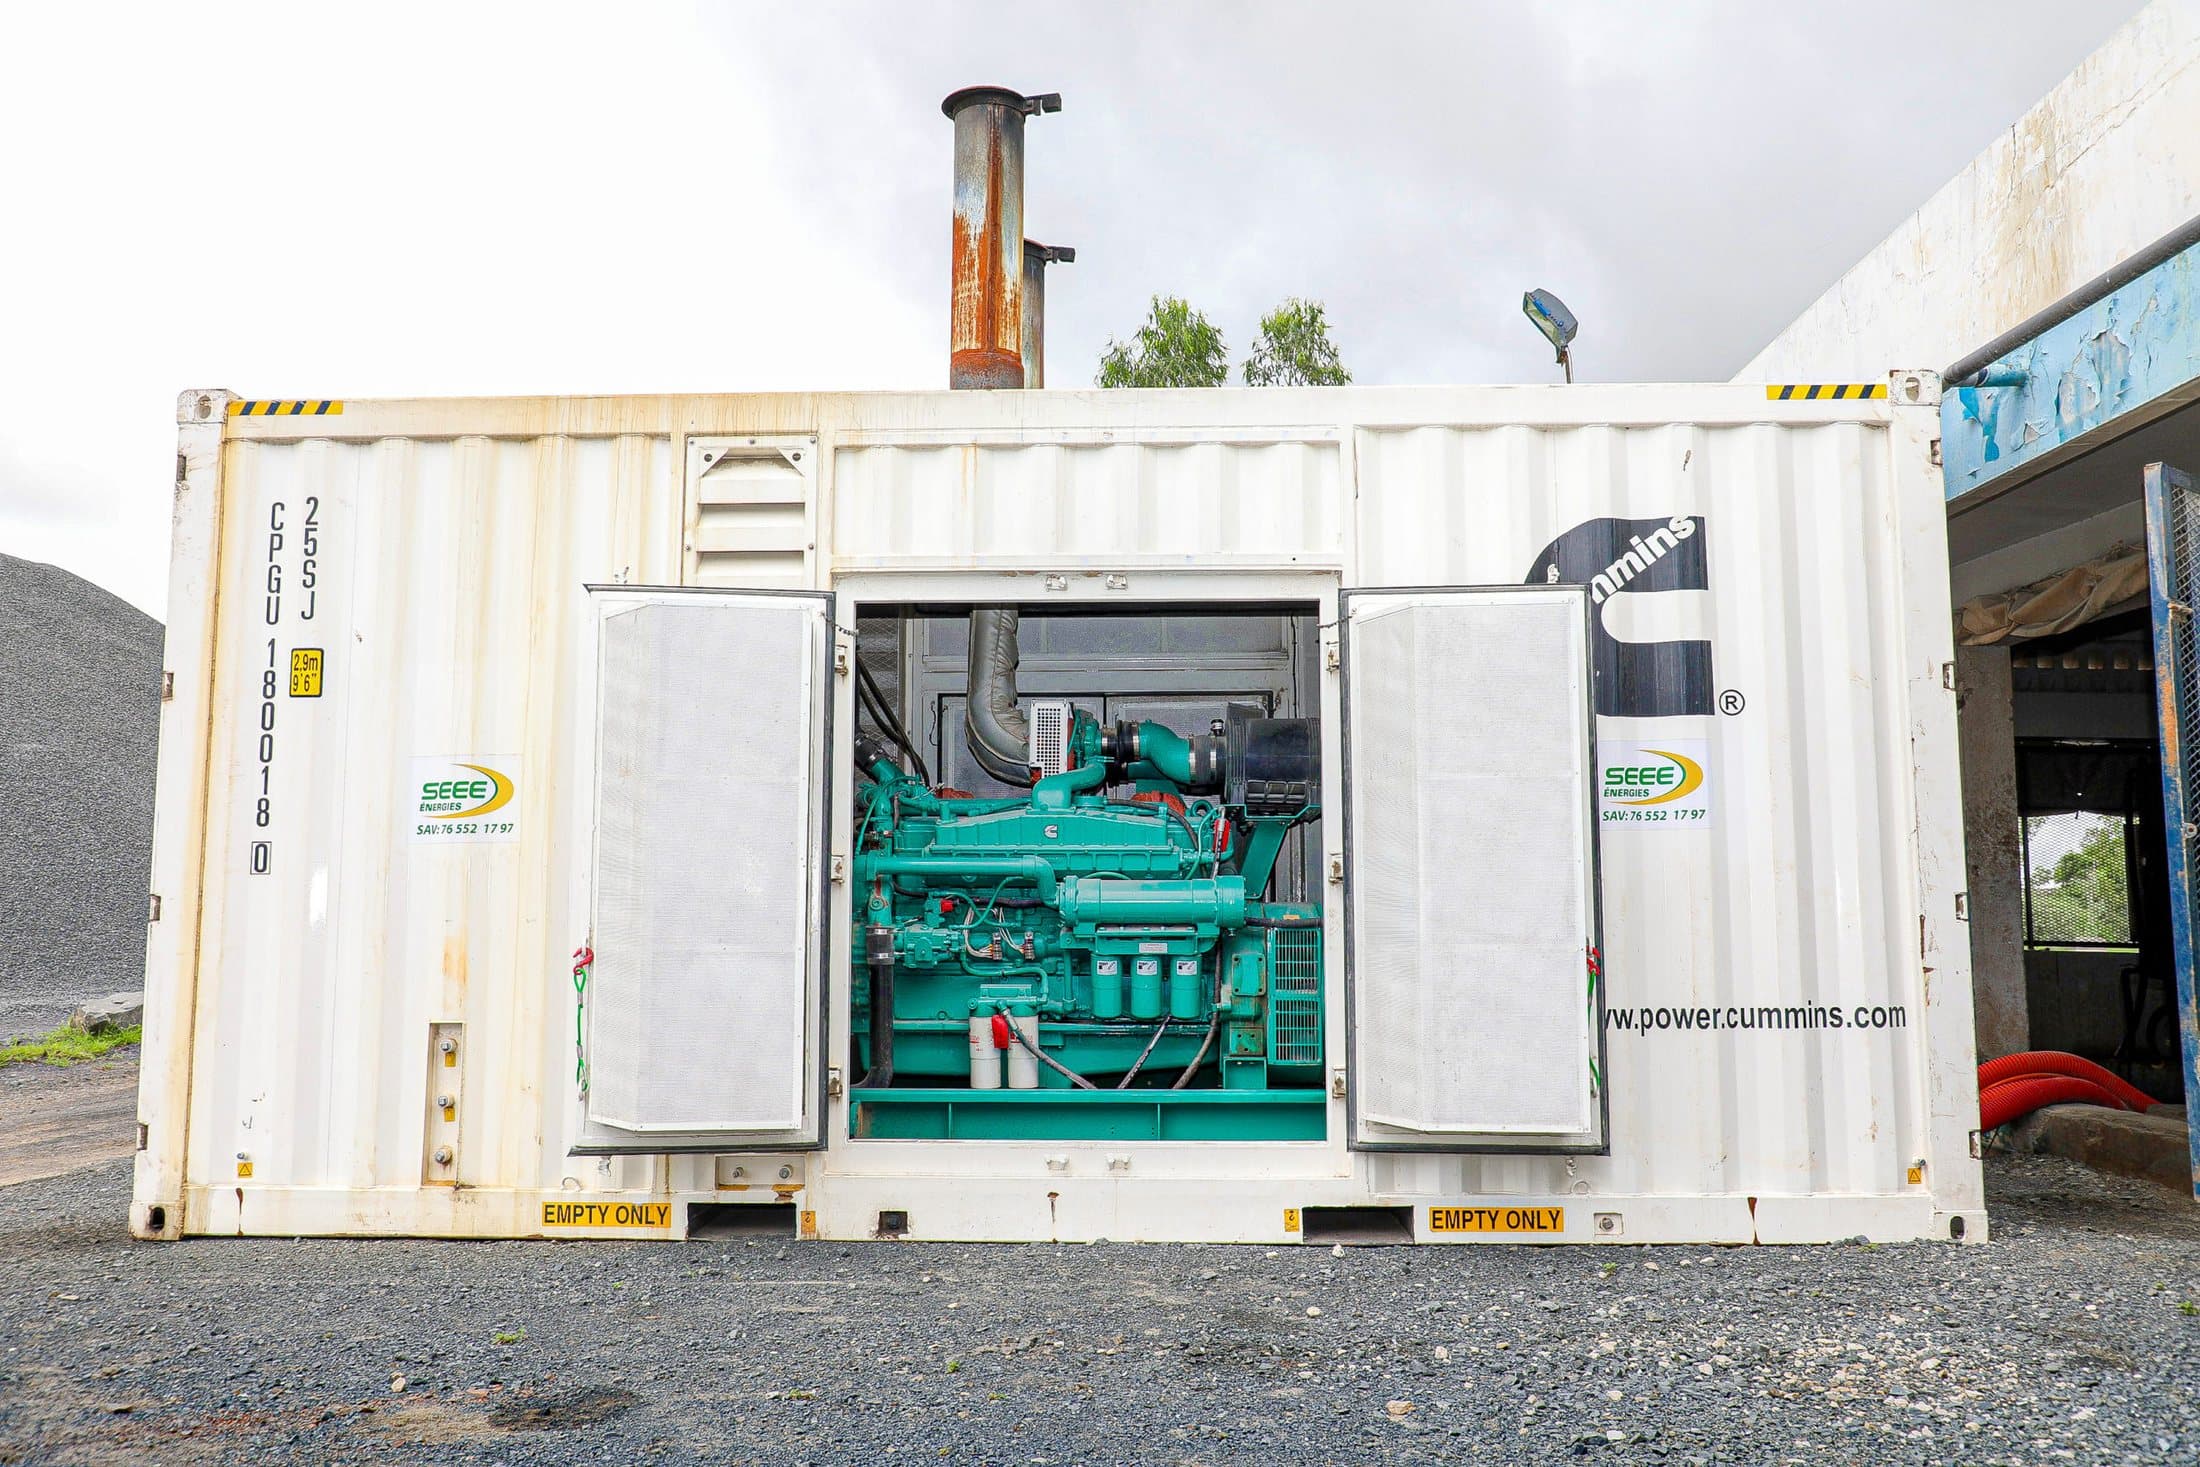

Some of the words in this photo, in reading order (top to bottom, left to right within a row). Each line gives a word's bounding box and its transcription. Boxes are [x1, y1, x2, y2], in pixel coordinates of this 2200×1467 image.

[266, 502, 285, 626] CPGU
[294, 653, 319, 672] 2.9m
[256, 638, 277, 828] 180018
[1605, 767, 1675, 785] SEEE
[421, 781, 488, 800] SEEE
[1644, 810, 1668, 821] 552
[455, 823, 478, 834] 552
[544, 1204, 609, 1224] EMPTY
[615, 1205, 669, 1225] ONLY
[1432, 1209, 1500, 1230] EMPTY
[1506, 1209, 1561, 1230] ONLY
